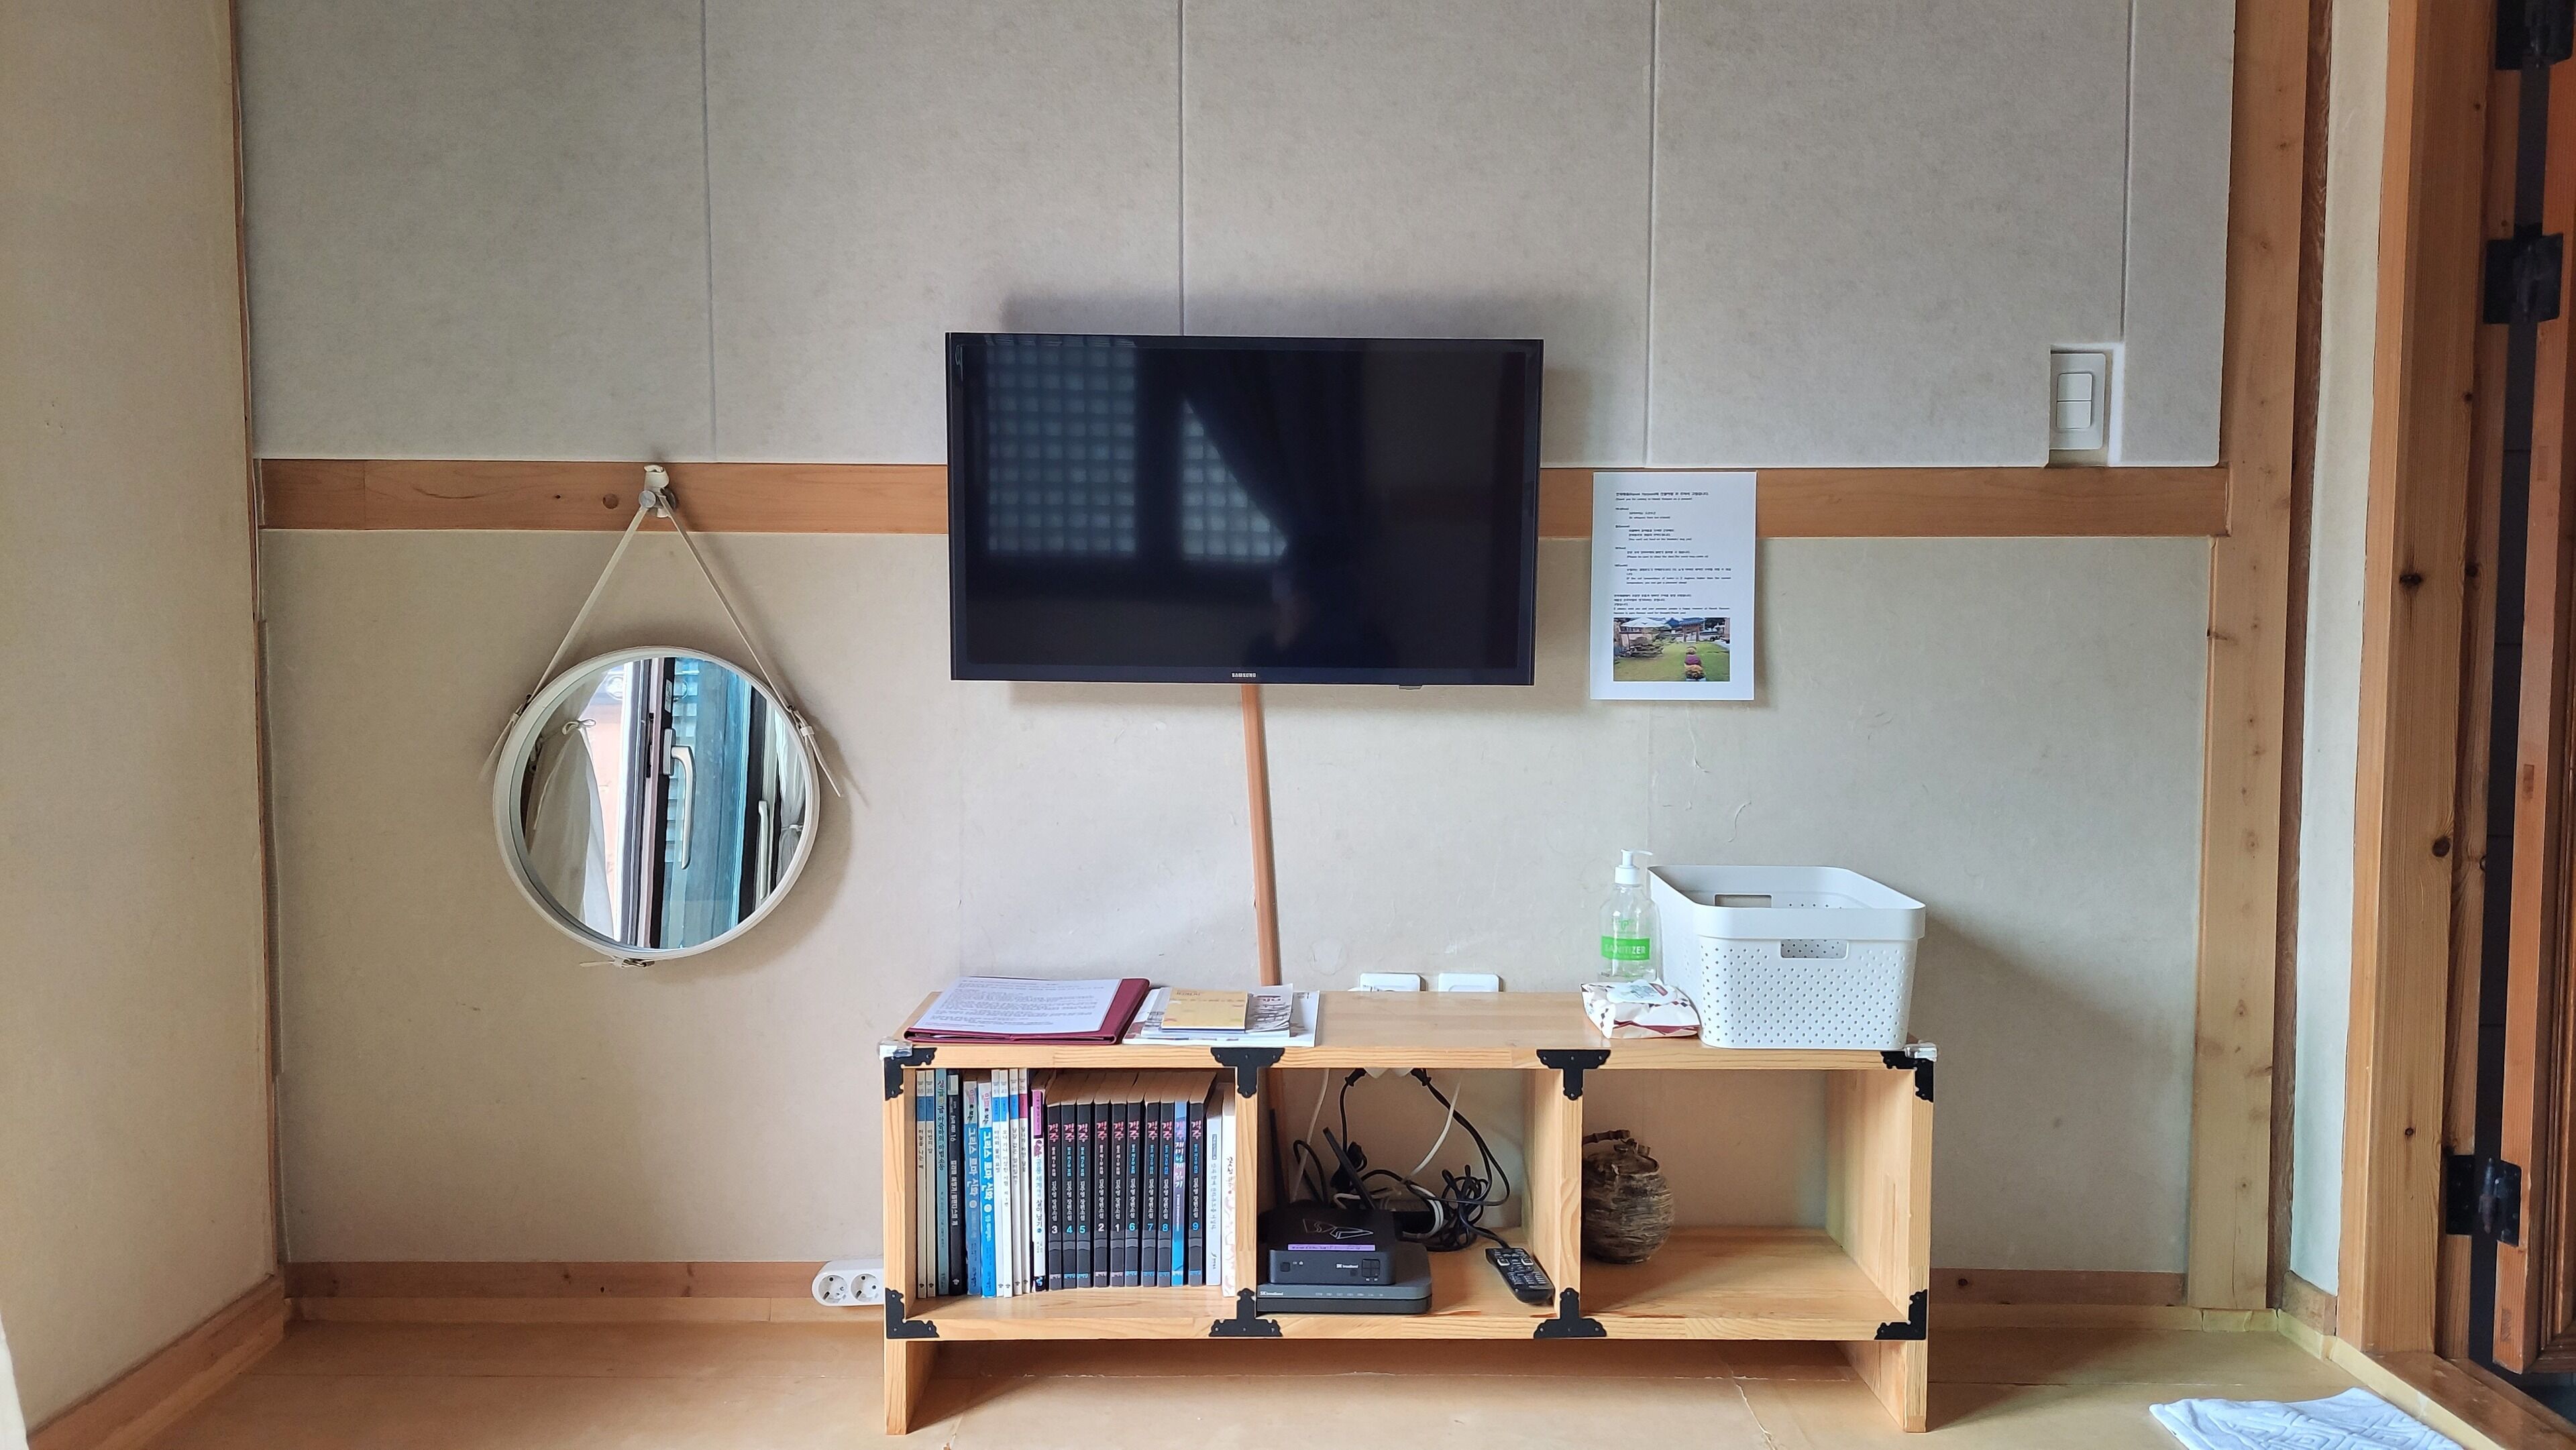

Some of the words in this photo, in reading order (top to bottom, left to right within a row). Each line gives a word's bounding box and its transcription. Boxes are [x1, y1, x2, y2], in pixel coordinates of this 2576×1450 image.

[950, 1134, 957, 1142] 16
[1048, 1123, 1059, 1143] 객주
[1064, 1123, 1075, 1143] 객주
[1078, 1123, 1088, 1143] 객주
[1097, 1121, 1108, 1141] 객주
[1114, 1121, 1124, 1141] 객주
[1128, 1121, 1140, 1140] 객주
[1147, 1121, 1158, 1140] 객주
[1161, 1121, 1172, 1141] 객주
[1176, 1121, 1185, 1140] 객주
[1191, 1120, 1201, 1139] 객주
[968, 1127, 977, 1154] 그리스
[983, 1131, 991, 1159] 그리스
[1175, 1141, 1185, 1169] 재미나게
[969, 1158, 977, 1175] 로마
[984, 1161, 993, 1180] 로마
[967, 1177, 979, 1196] 신화
[981, 1182, 994, 1201] 신화
[1052, 1225, 1058, 1234] 3
[1067, 1225, 1073, 1234] 4
[1079, 1225, 1086, 1233] 5
[1098, 1223, 1105, 1232] 2
[1115, 1223, 1120, 1232] 1
[1128, 1223, 1136, 1231] 6
[1147, 1223, 1154, 1231] 7
[1162, 1223, 1169, 1232] 8
[1192, 1222, 1199, 1231] 9
